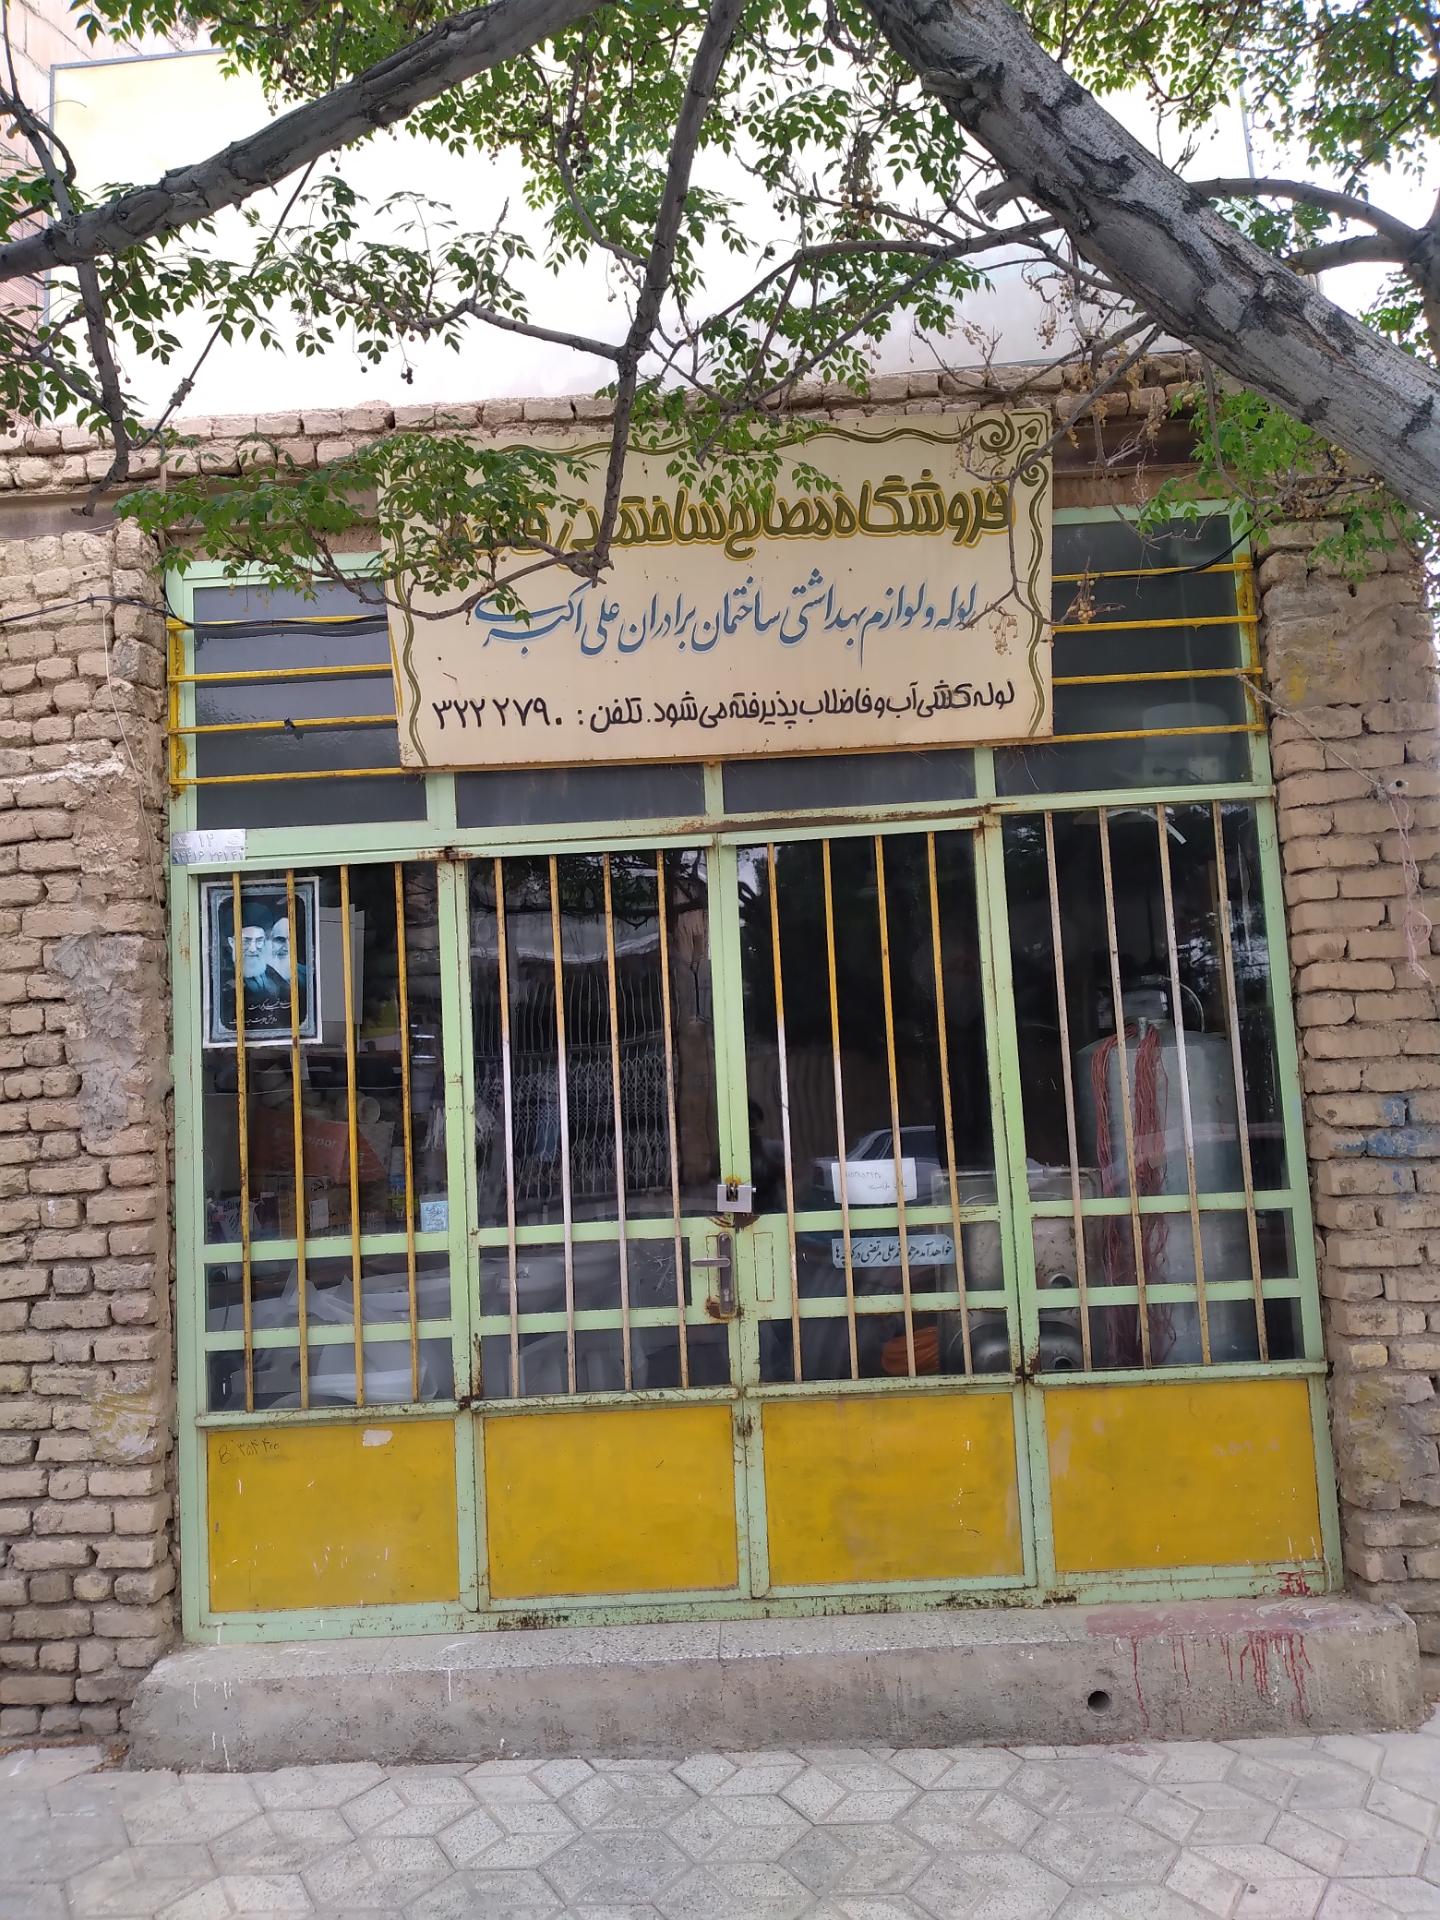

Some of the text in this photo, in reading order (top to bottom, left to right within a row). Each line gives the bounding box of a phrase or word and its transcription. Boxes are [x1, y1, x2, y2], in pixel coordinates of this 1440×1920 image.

[724, 481, 834, 561] مصالح
[834, 468, 1016, 548] فروشگاه
[580, 595, 620, 656] علی
[617, 592, 697, 654] برادران
[691, 576, 781, 652] ساختمان
[779, 567, 867, 647] بهداشتی
[861, 582, 926, 670] لوازم
[922, 606, 935, 629] و
[933, 581, 977, 631] لوله
[728, 689, 800, 730] پذیرفته
[801, 686, 873, 724] فاضلاب
[876, 695, 888, 719] و
[886, 681, 919, 719] آب
[918, 1241, 934, 1258] آمد
[931, 1241, 953, 1257] خواهد
